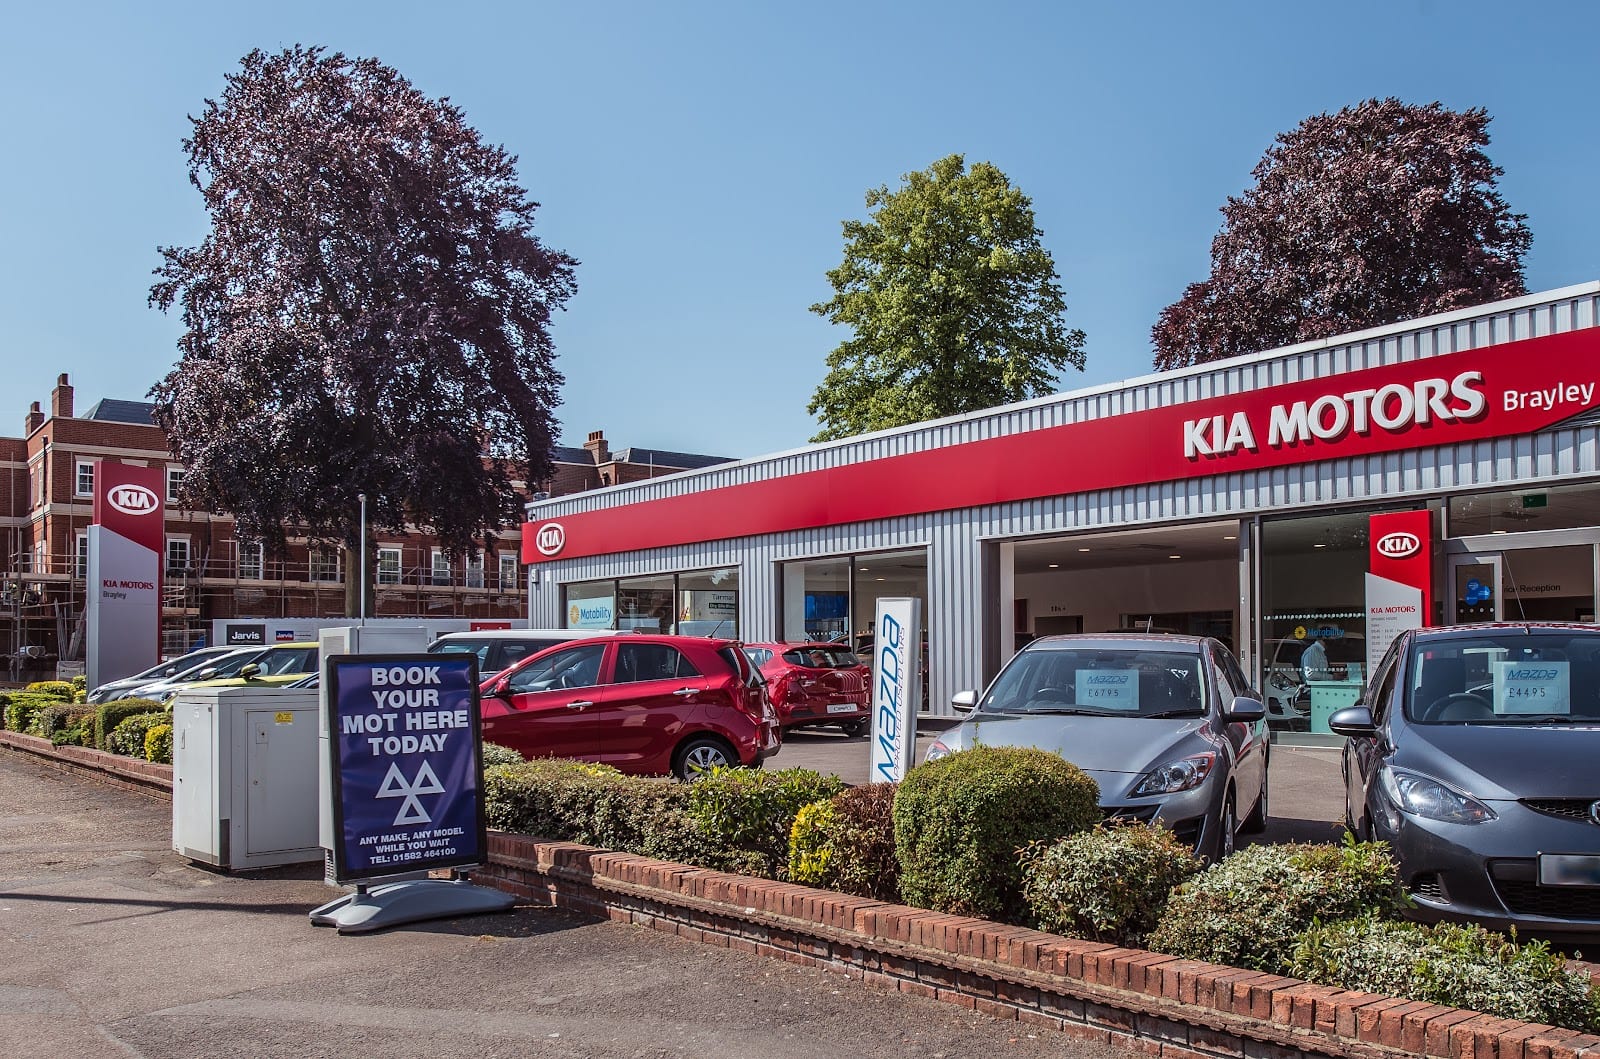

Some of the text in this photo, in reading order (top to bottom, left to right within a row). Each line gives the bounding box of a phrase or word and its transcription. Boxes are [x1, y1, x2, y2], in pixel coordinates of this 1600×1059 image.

[1183, 371, 1597, 459] KIA MOTORS Brayley
[118, 490, 150, 509] KIA
[541, 530, 560, 548] KIA
[1384, 537, 1413, 552] KIA
[103, 580, 154, 590] KIA MOTORS
[1519, 583, 1561, 593] Reception
[103, 590, 127, 600] Brayley
[580, 606, 612, 621] Motability
[1385, 605, 1416, 613] MOTORS
[231, 631, 260, 640] Jarvis
[1307, 627, 1345, 639] Motability
[371, 666, 441, 686] BOOK
[372, 689, 440, 709] YOUR
[1088, 689, 1119, 698] £6795
[1509, 687, 1546, 698] £4495
[342, 710, 469, 734] MOT HERE
[368, 733, 448, 756] TODAY
[359, 827, 465, 845] ANY MAKE, ANY MODEL
[375, 838, 450, 854] WHILE YOU WAIT
[369, 847, 457, 865] TEL: 01582 464100
